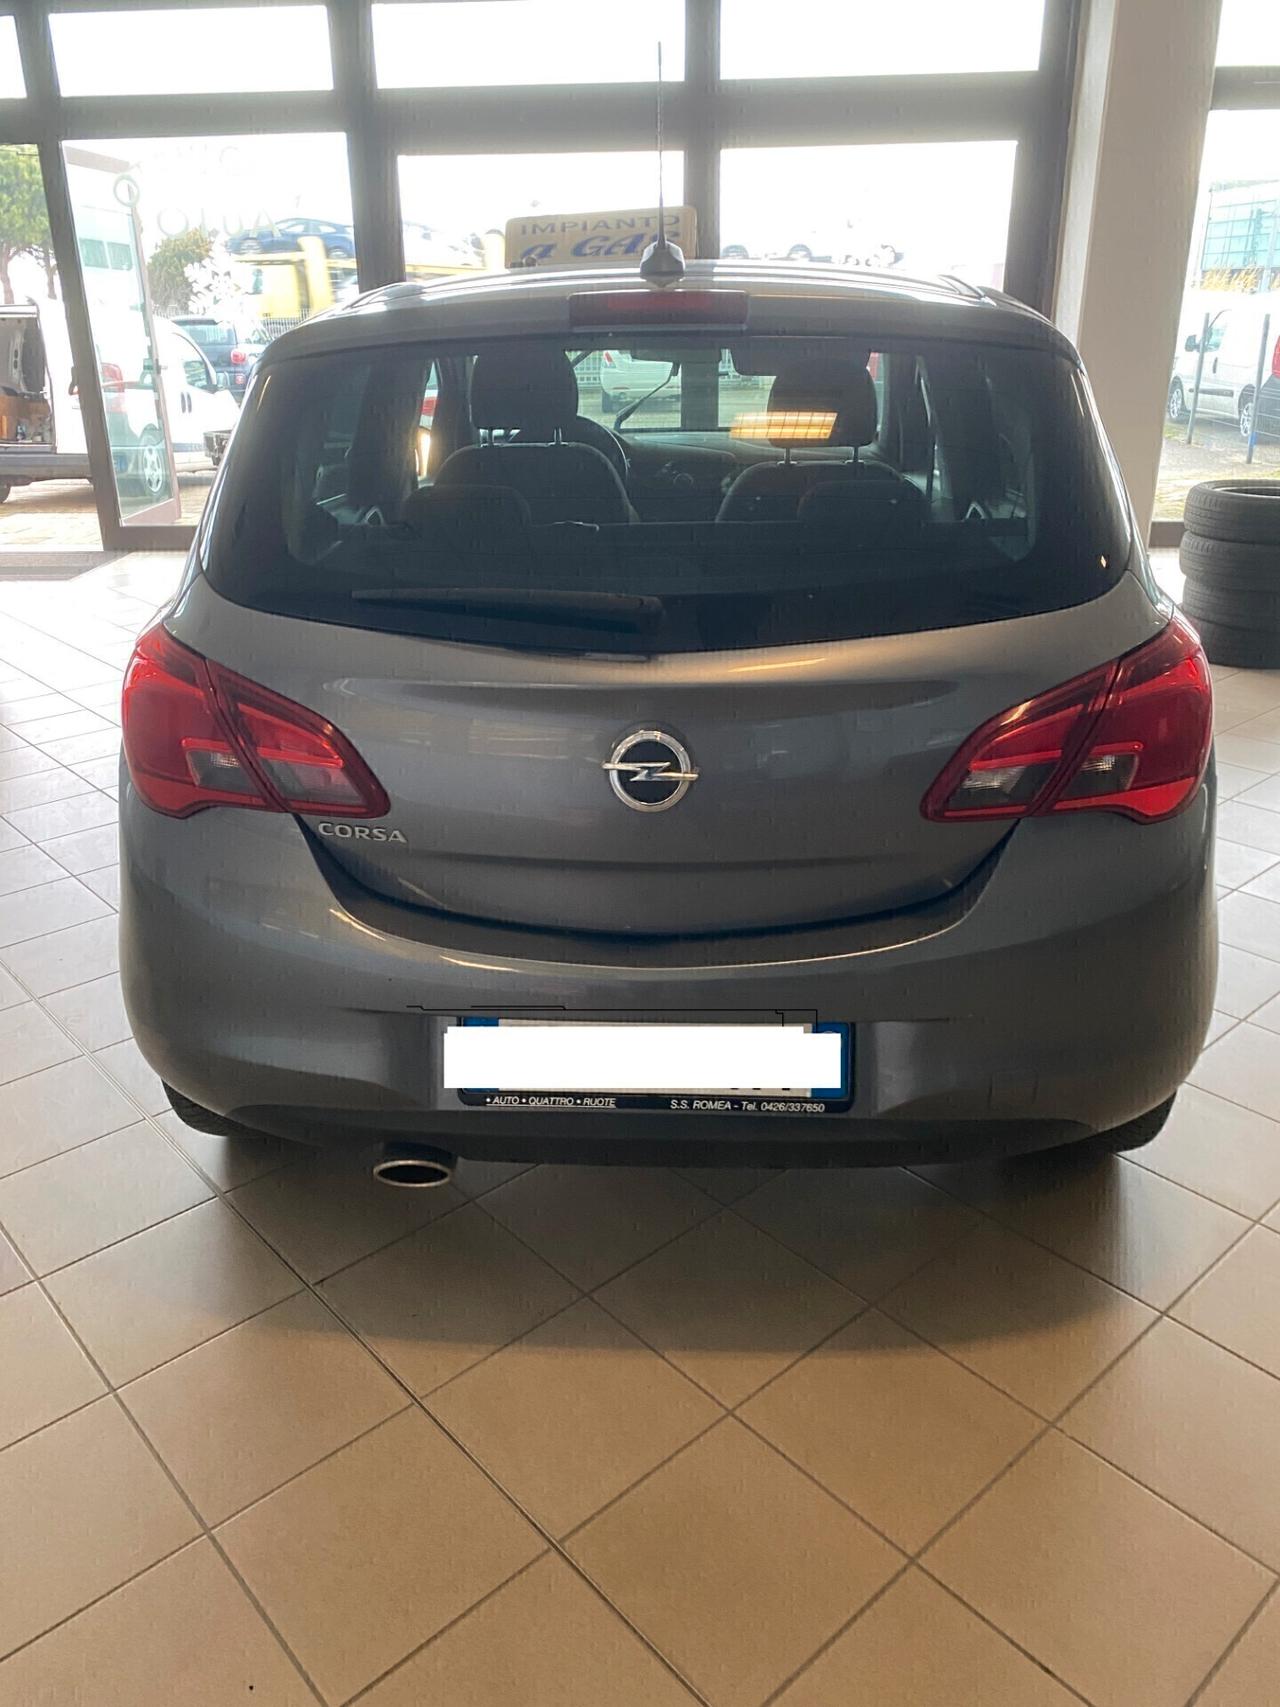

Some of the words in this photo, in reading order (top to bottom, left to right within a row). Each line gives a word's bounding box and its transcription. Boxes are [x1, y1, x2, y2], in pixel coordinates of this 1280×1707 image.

[521, 215, 680, 235] IMPIANTO
[318, 822, 408, 843] CORSA
[492, 1096, 520, 1105] AUTO
[528, 1096, 574, 1106] QUATTRO
[583, 1097, 617, 1107] RUOTE
[670, 1100, 690, 1109] S.S.
[693, 1100, 731, 1110] ROMEA
[742, 1101, 758, 1111] Tel.
[761, 1101, 825, 1113] 0426/337650
